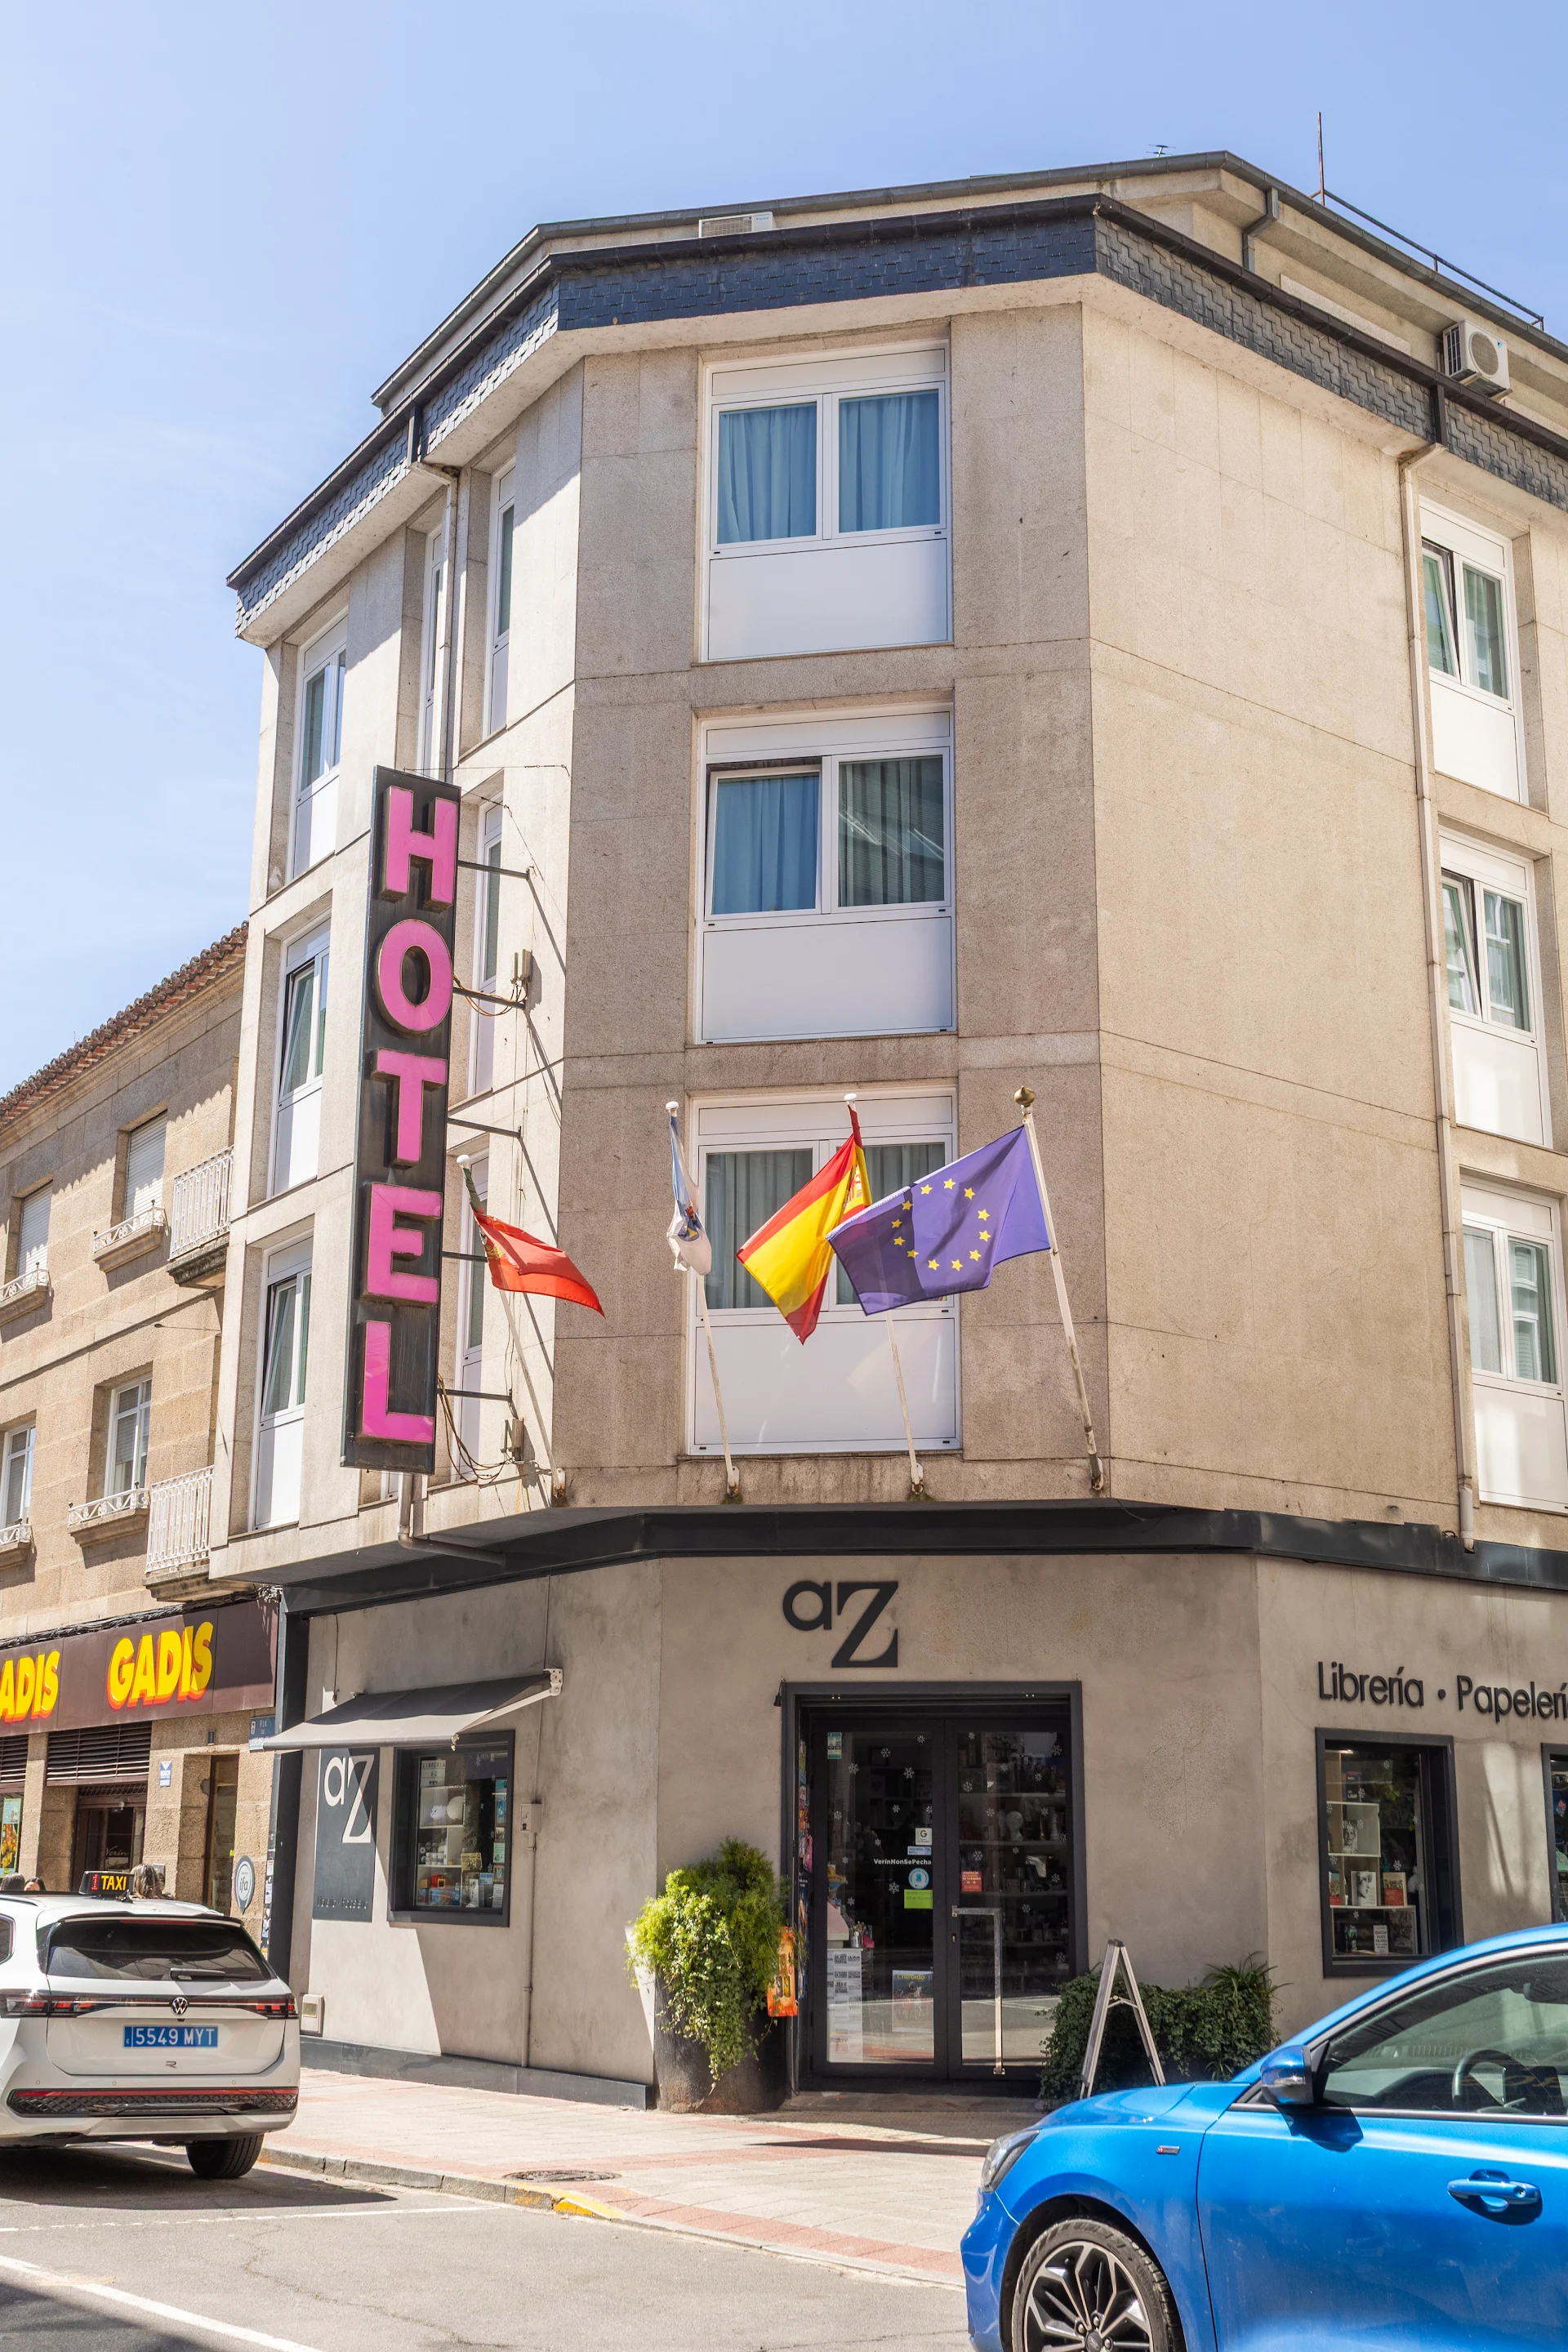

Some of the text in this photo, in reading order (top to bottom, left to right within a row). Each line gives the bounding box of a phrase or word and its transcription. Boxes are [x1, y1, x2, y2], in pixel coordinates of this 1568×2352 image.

[359, 785, 458, 1445] HOTEL
[0, 1650, 60, 1724] ADIS
[106, 1621, 213, 1712] GADIS
[1317, 1661, 1568, 1723] Librería Papelerí
[101, 1874, 127, 1891] TAXI
[239, 1878, 248, 1893] ifa
[136, 2028, 179, 2045] 5549
[184, 2028, 215, 2045] MYT
